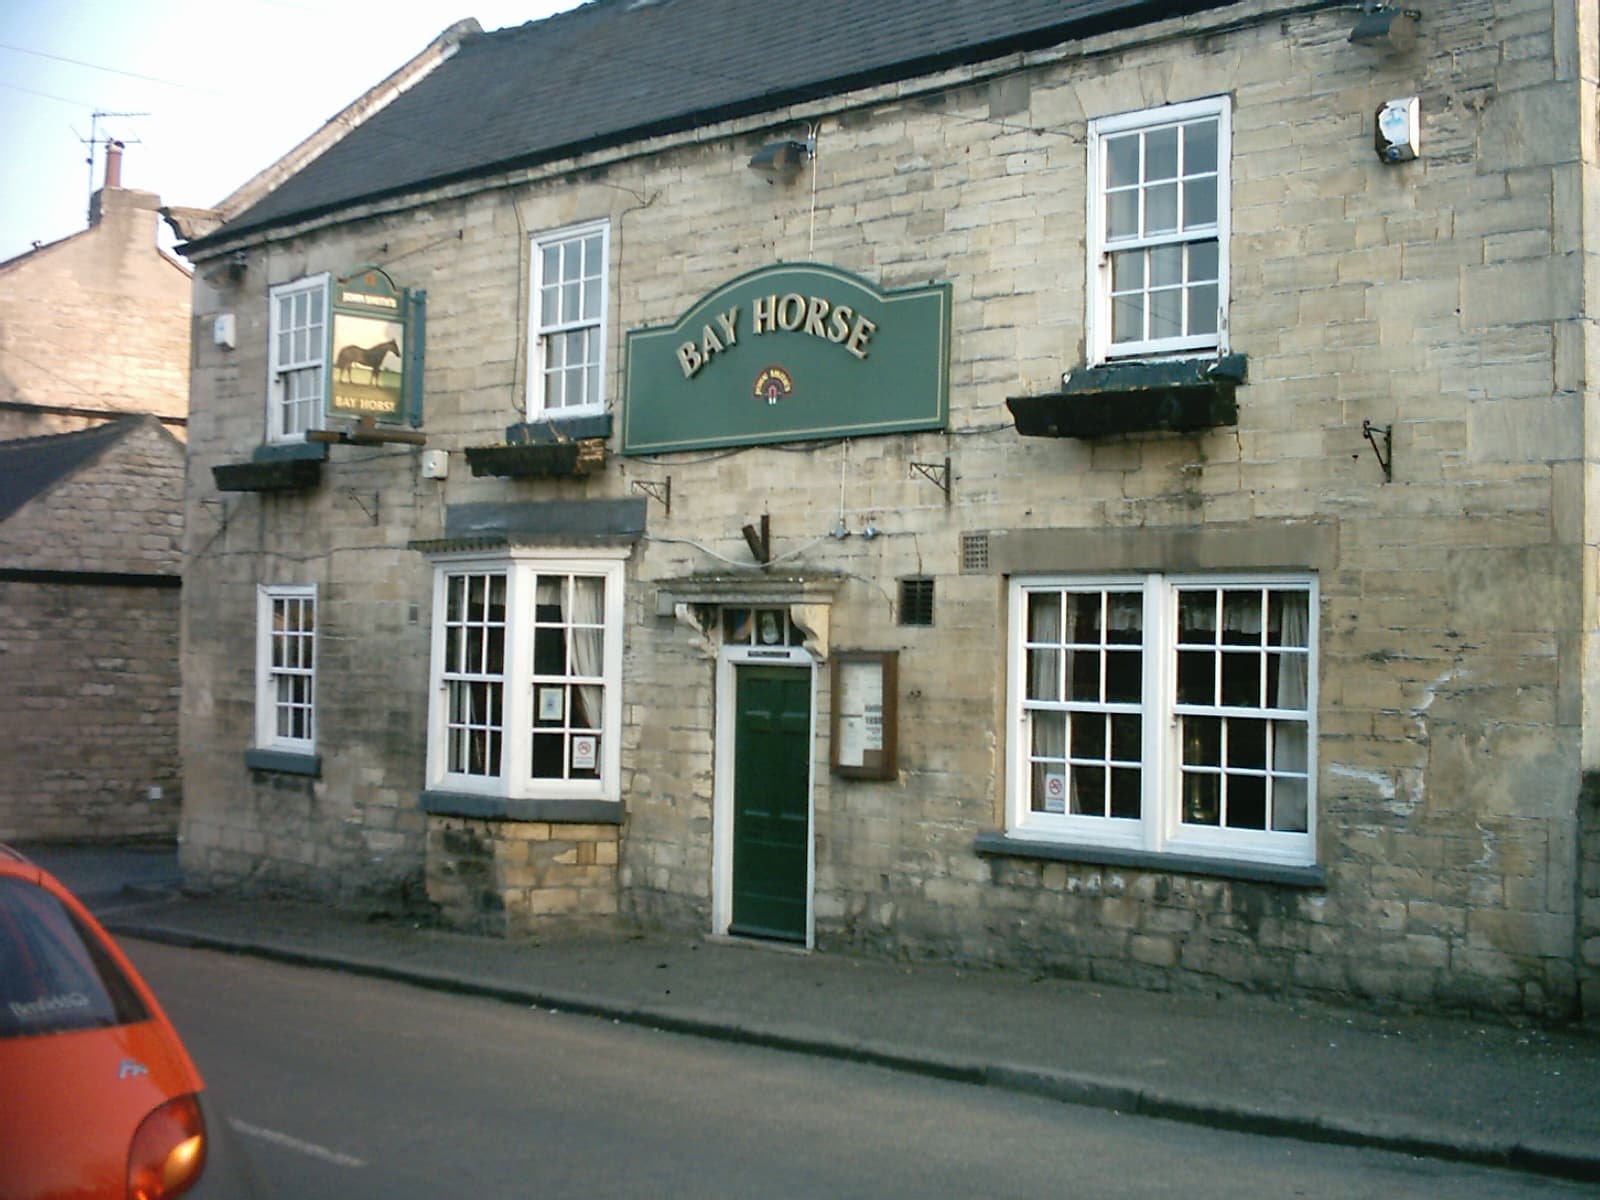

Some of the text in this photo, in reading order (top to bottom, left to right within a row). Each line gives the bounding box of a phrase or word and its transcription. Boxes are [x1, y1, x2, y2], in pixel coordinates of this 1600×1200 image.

[676, 292, 878, 379] BAY HORSE
[335, 395, 396, 413] BAY HORSE
